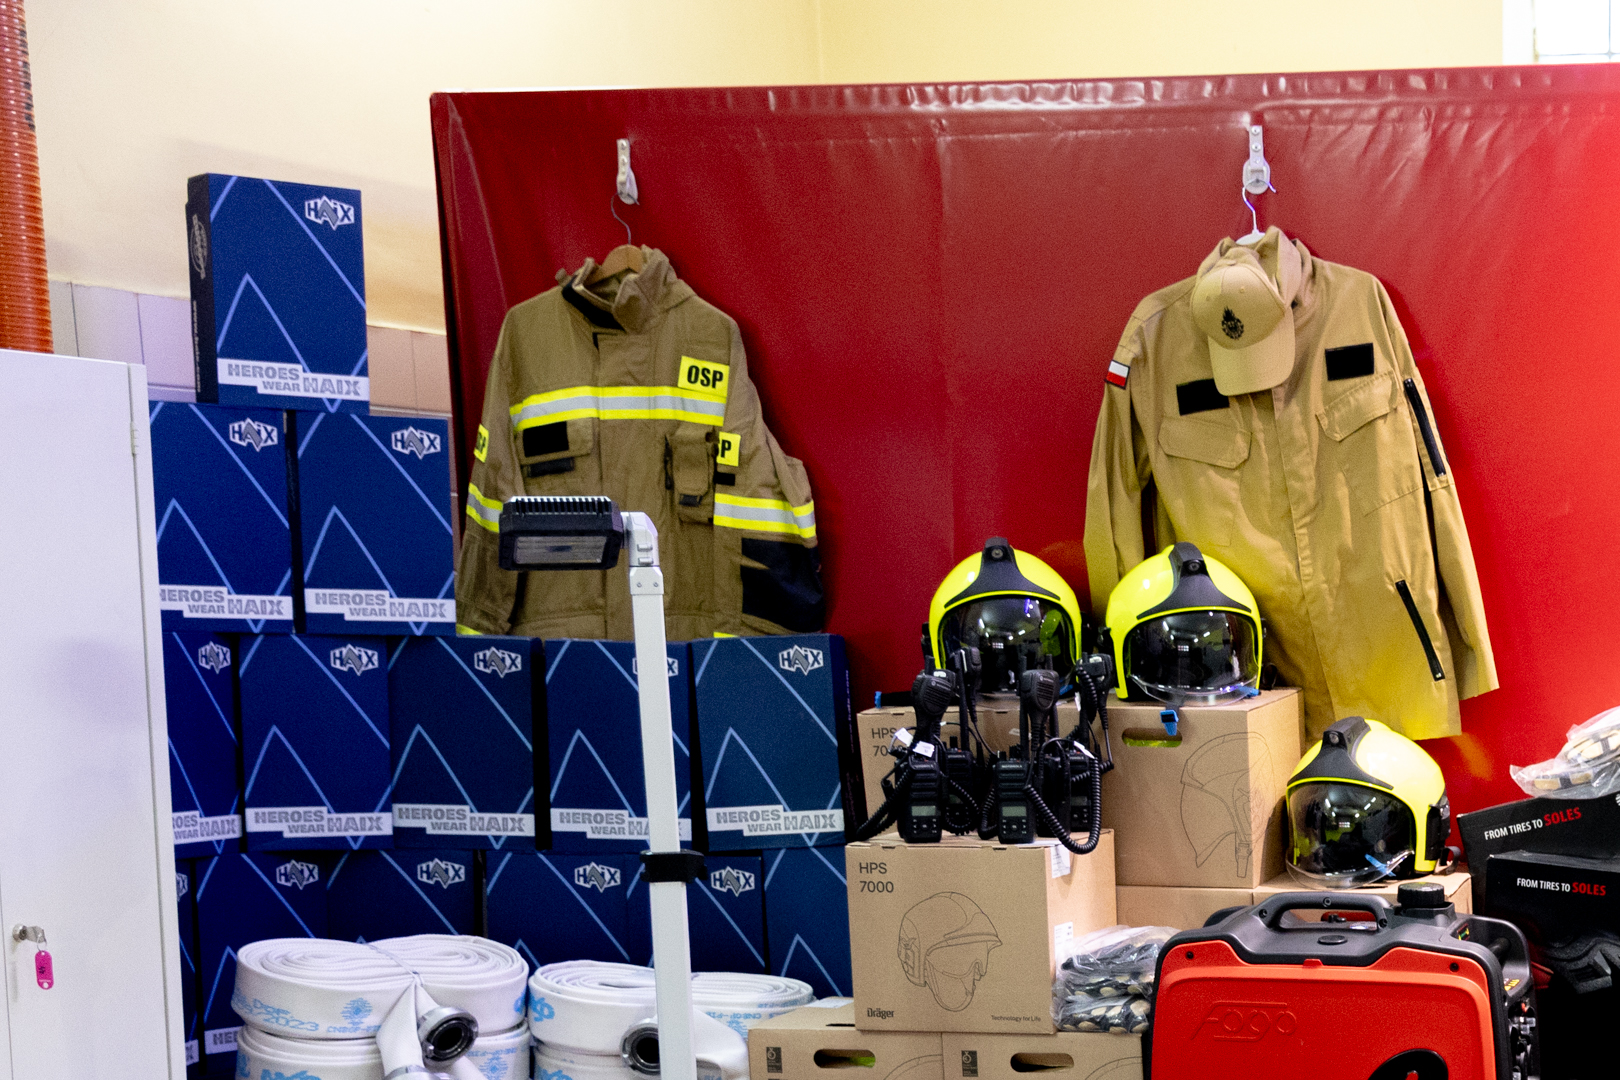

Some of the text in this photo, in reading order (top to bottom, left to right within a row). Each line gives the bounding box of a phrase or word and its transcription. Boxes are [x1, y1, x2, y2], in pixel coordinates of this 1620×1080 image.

[227, 363, 300, 381] HEROES
[686, 364, 724, 389] OSP
[262, 377, 360, 396] WEAR HAIX
[187, 598, 284, 616] WEAR HAIX
[314, 592, 387, 606] HEROES
[349, 601, 446, 618] WEAR HAIX
[254, 810, 324, 824] HEROES
[398, 807, 467, 821] HEROES
[559, 811, 626, 825] HEROES
[715, 808, 781, 825] HEROES
[173, 817, 236, 840] WEAR HAIX
[287, 815, 383, 834] WEAR HAIX
[430, 815, 525, 832] WEAR HAIX
[590, 824, 626, 836] WEAR
[747, 813, 836, 834] WEAR HAIX
[1484, 807, 1582, 841] FROM TIRES TO SOLES
[859, 862, 887, 874] HPS
[859, 880, 894, 893] 7000
[1516, 877, 1606, 896] FROM TIRES TO SOLES
[867, 1007, 894, 1020] Dräger
[991, 1014, 1022, 1022] Technology
